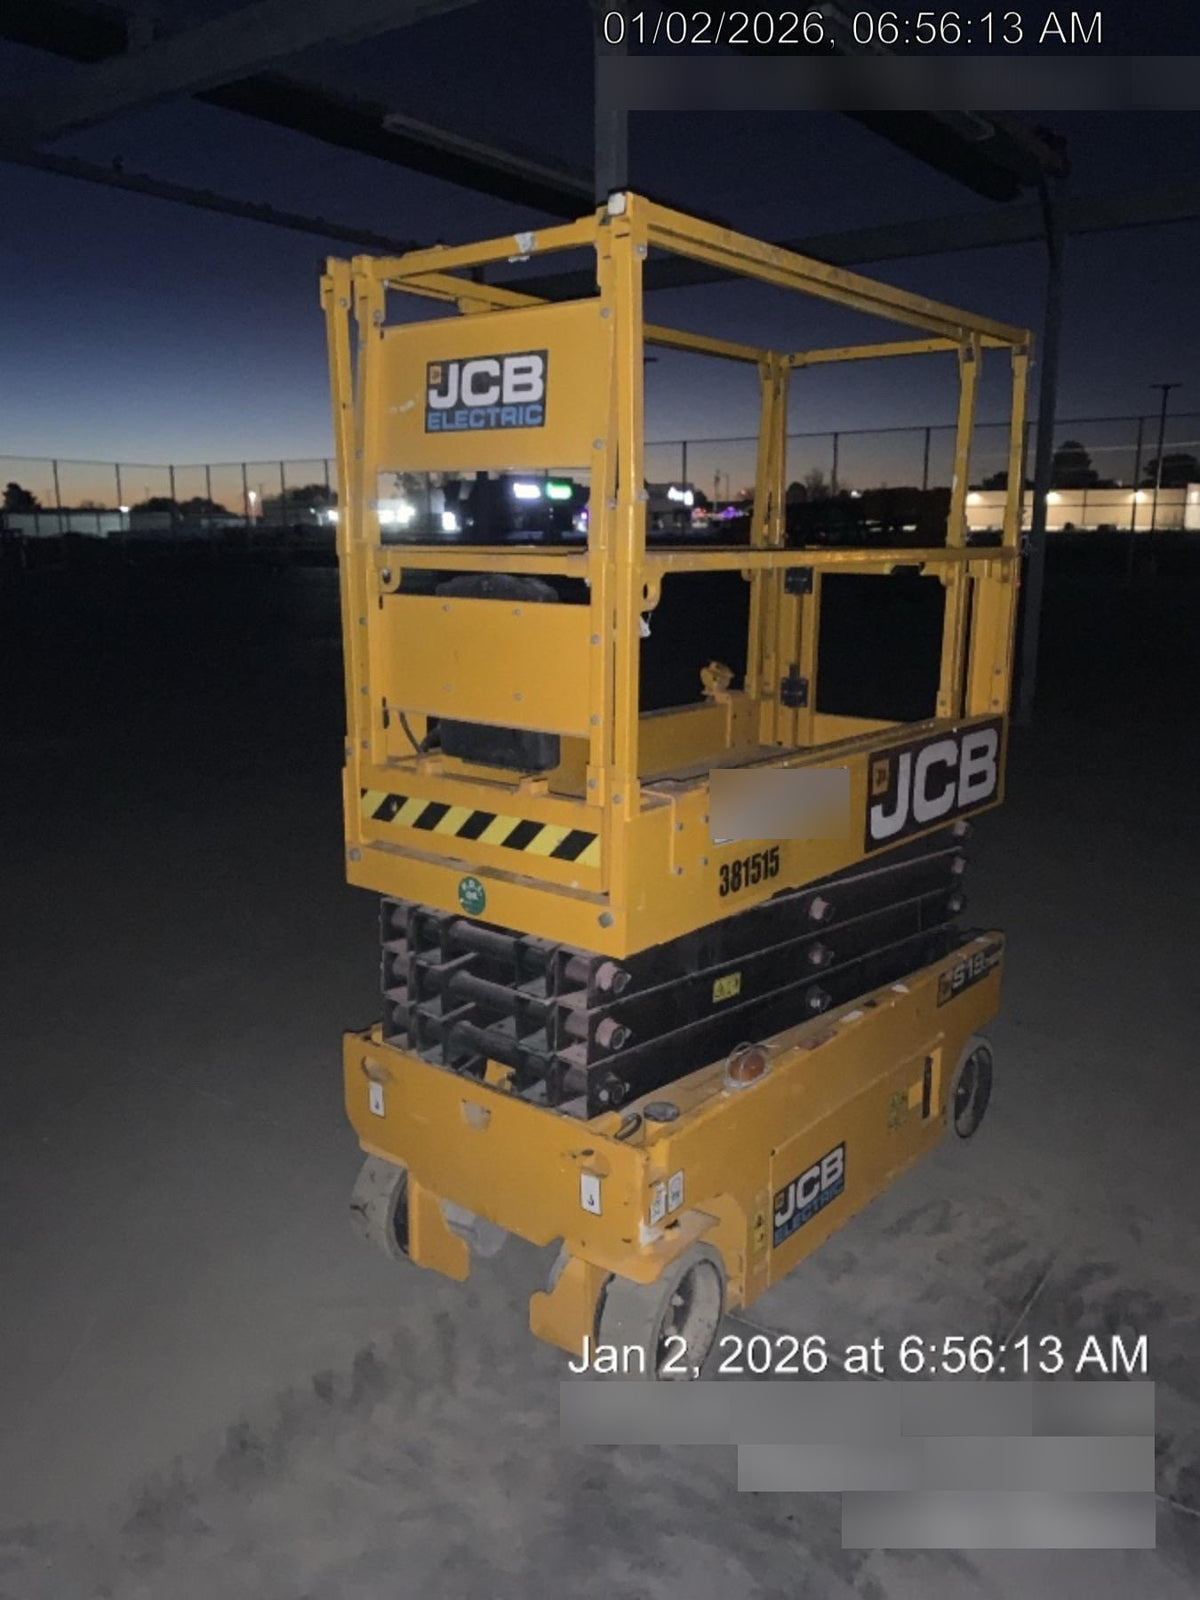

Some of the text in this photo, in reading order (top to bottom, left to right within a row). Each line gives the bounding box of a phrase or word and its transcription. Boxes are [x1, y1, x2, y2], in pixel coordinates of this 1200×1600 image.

[428, 355, 544, 410] JCB
[427, 404, 544, 431] ELECTRIC
[870, 728, 999, 840] JCB
[719, 846, 780, 897] 381515
[775, 1147, 844, 1228] JCB
